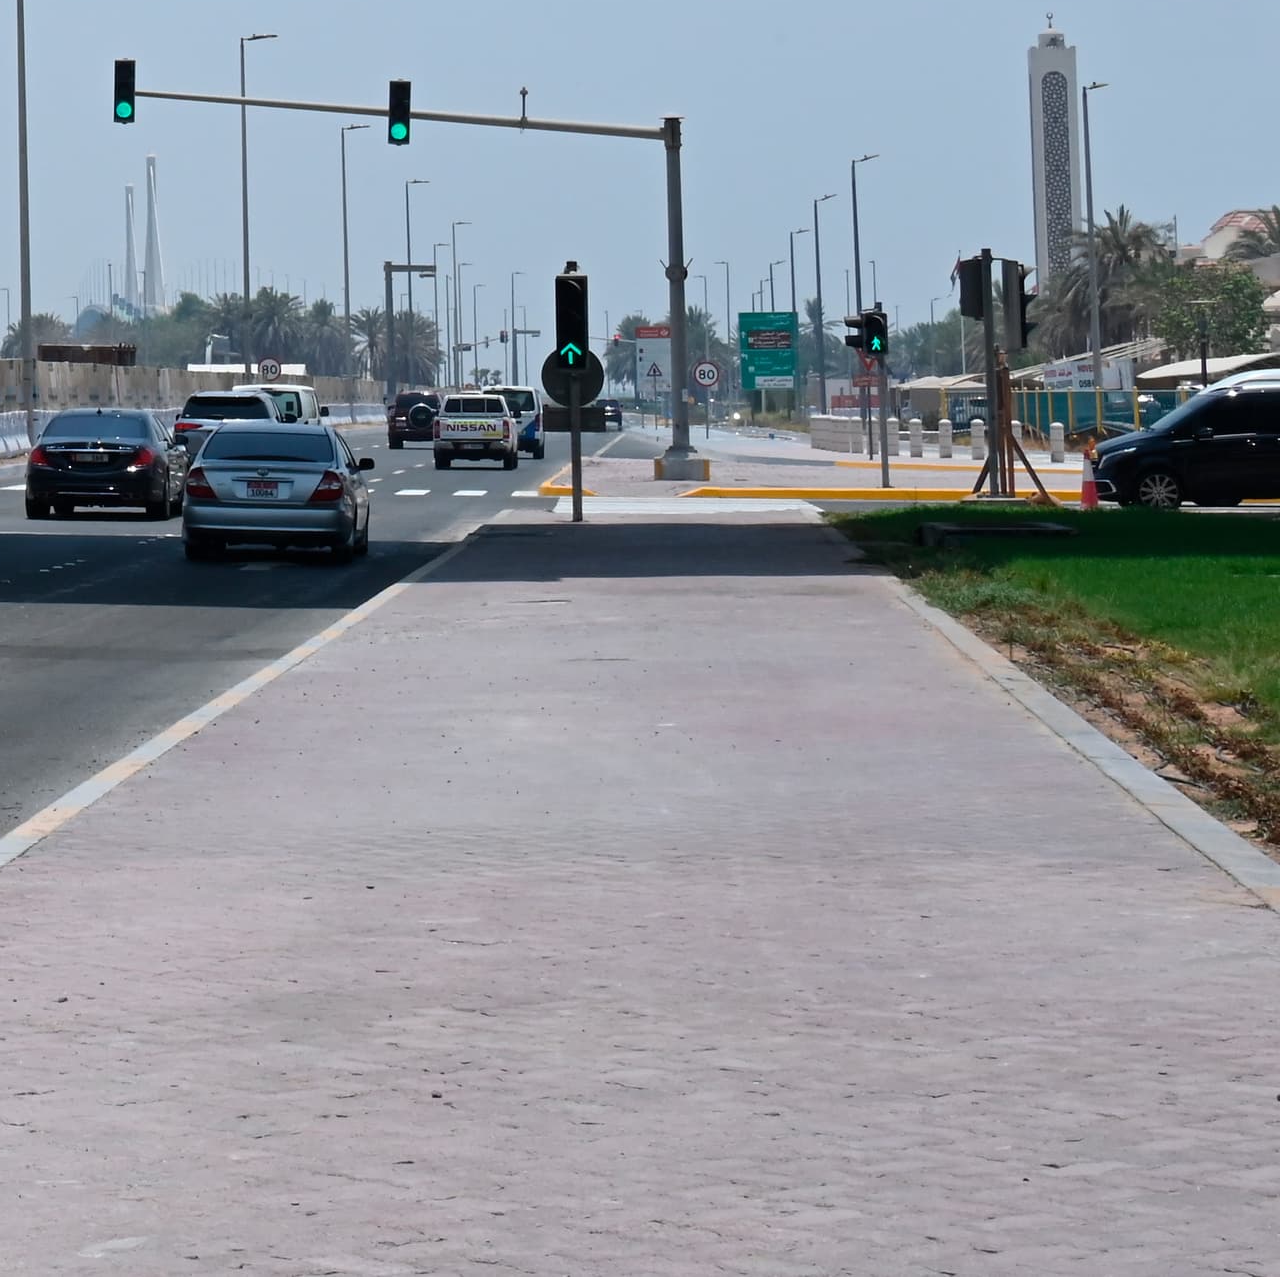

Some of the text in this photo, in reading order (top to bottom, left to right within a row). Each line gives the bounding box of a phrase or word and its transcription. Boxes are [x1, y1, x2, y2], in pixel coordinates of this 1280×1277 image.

[262, 364, 278, 375] 80
[698, 369, 715, 380] 80
[446, 424, 497, 432] NISSAN
